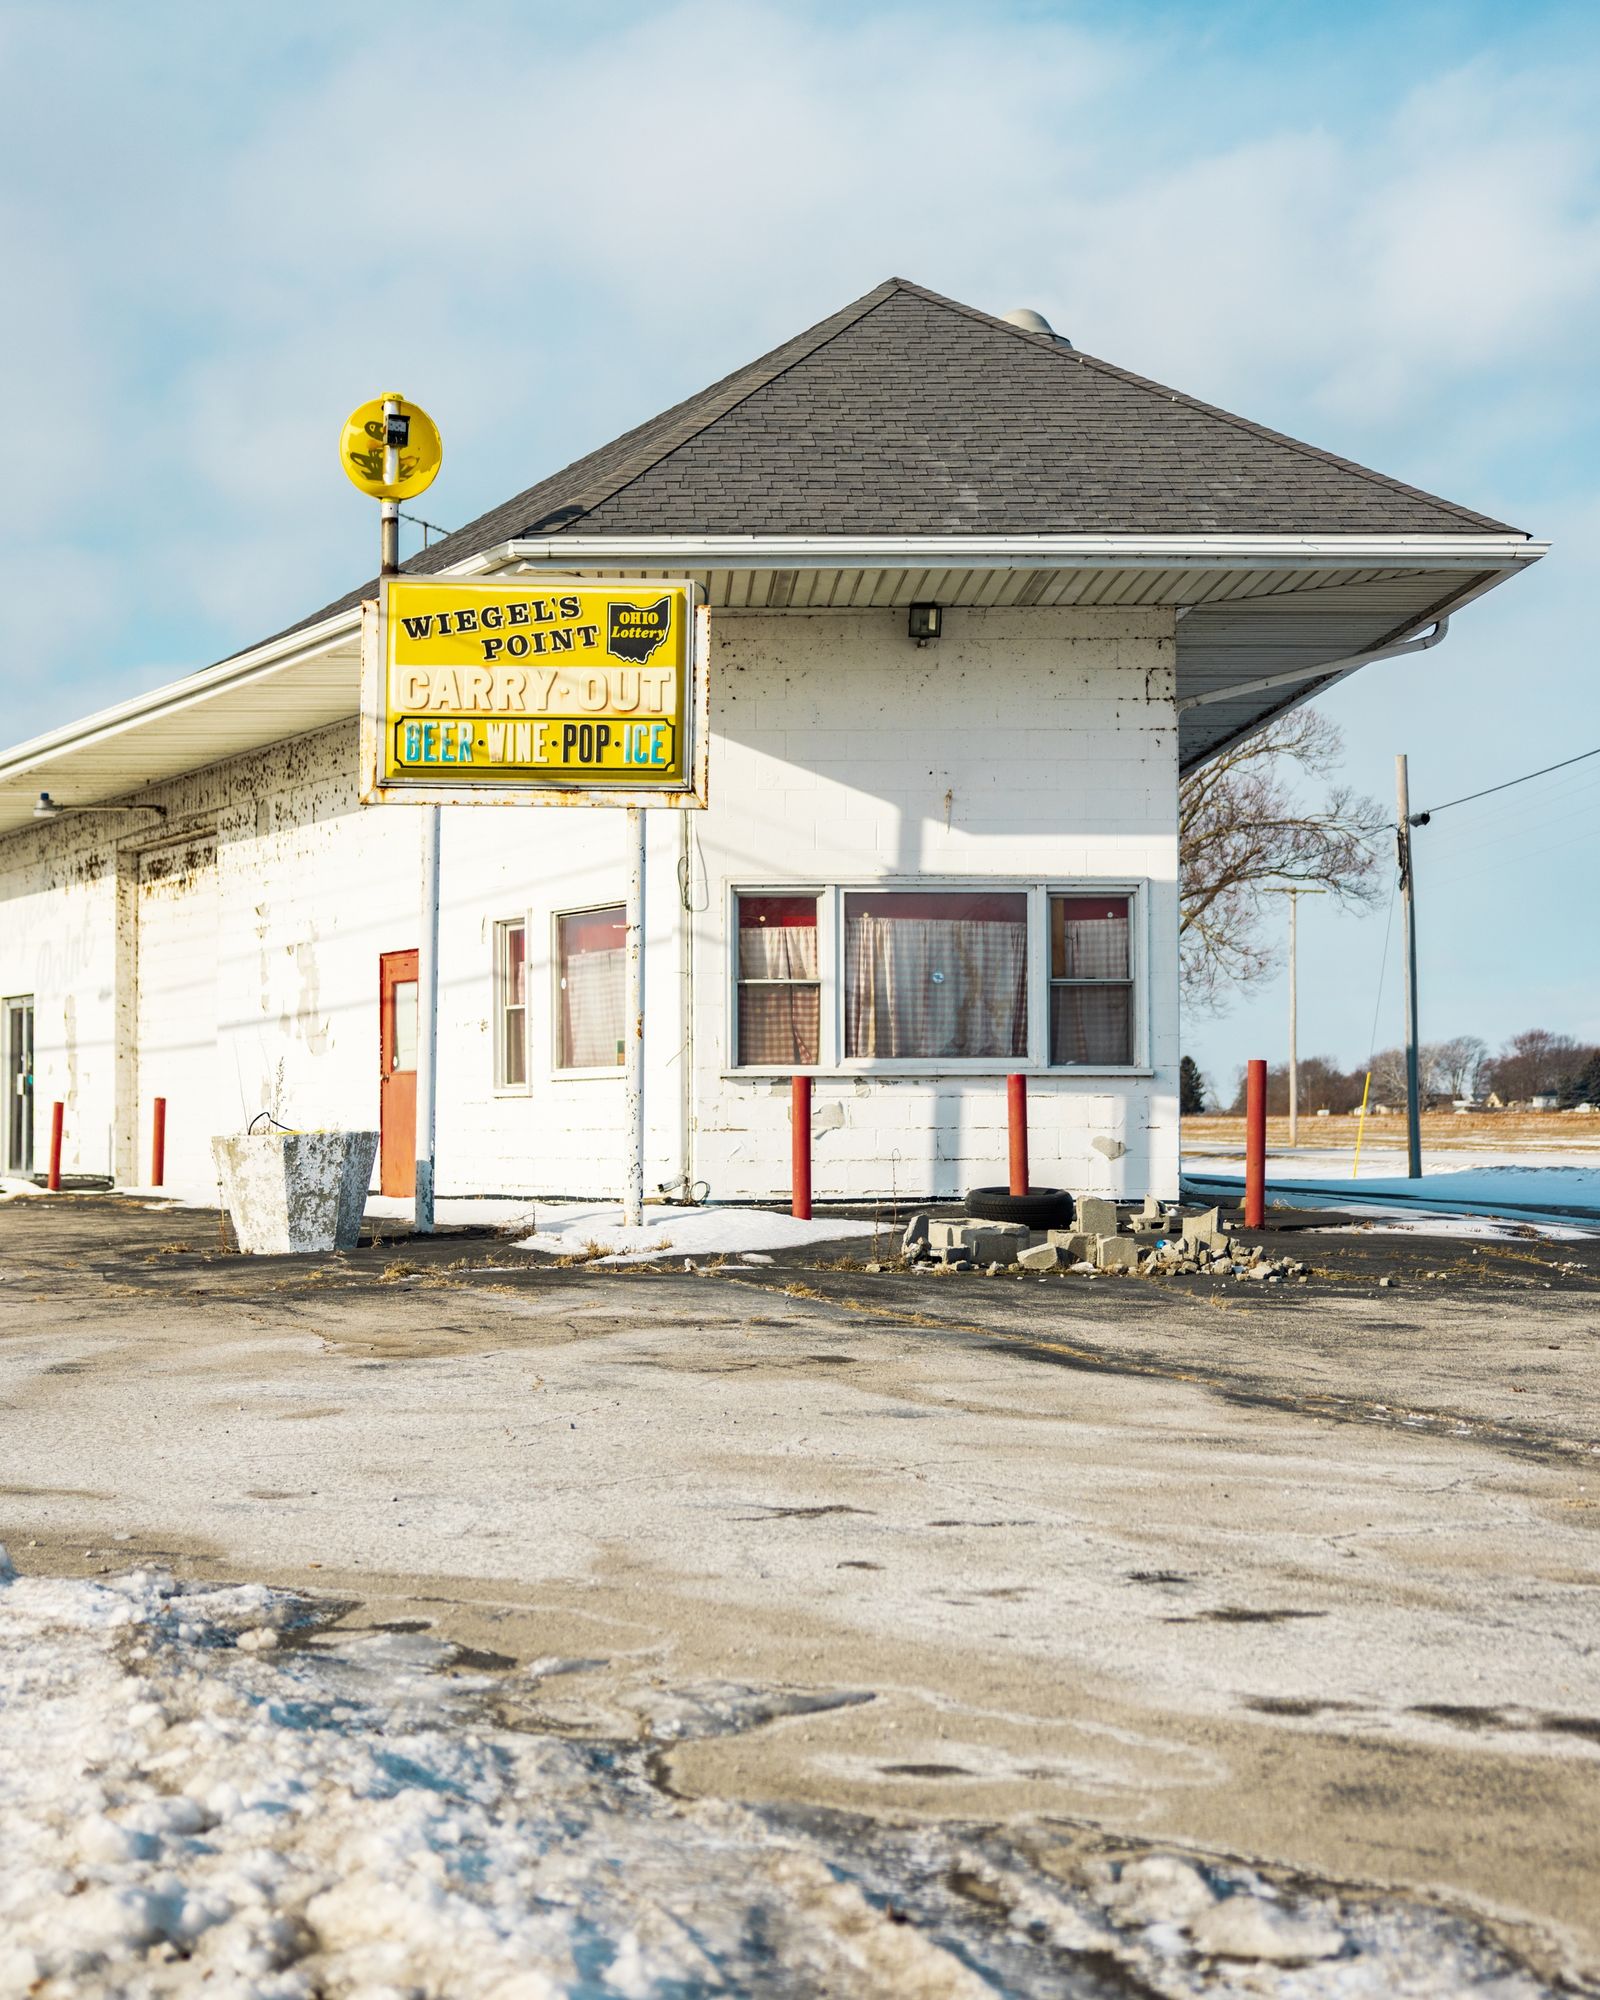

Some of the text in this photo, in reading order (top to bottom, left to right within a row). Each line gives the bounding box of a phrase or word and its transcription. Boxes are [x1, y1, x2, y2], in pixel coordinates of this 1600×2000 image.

[401, 595, 582, 639] WIEGEL'S
[611, 625, 666, 642] Lottery
[619, 611, 659, 625] OHIO
[481, 625, 600, 661] POINT
[404, 721, 666, 765] BEER WINE POP ICE
